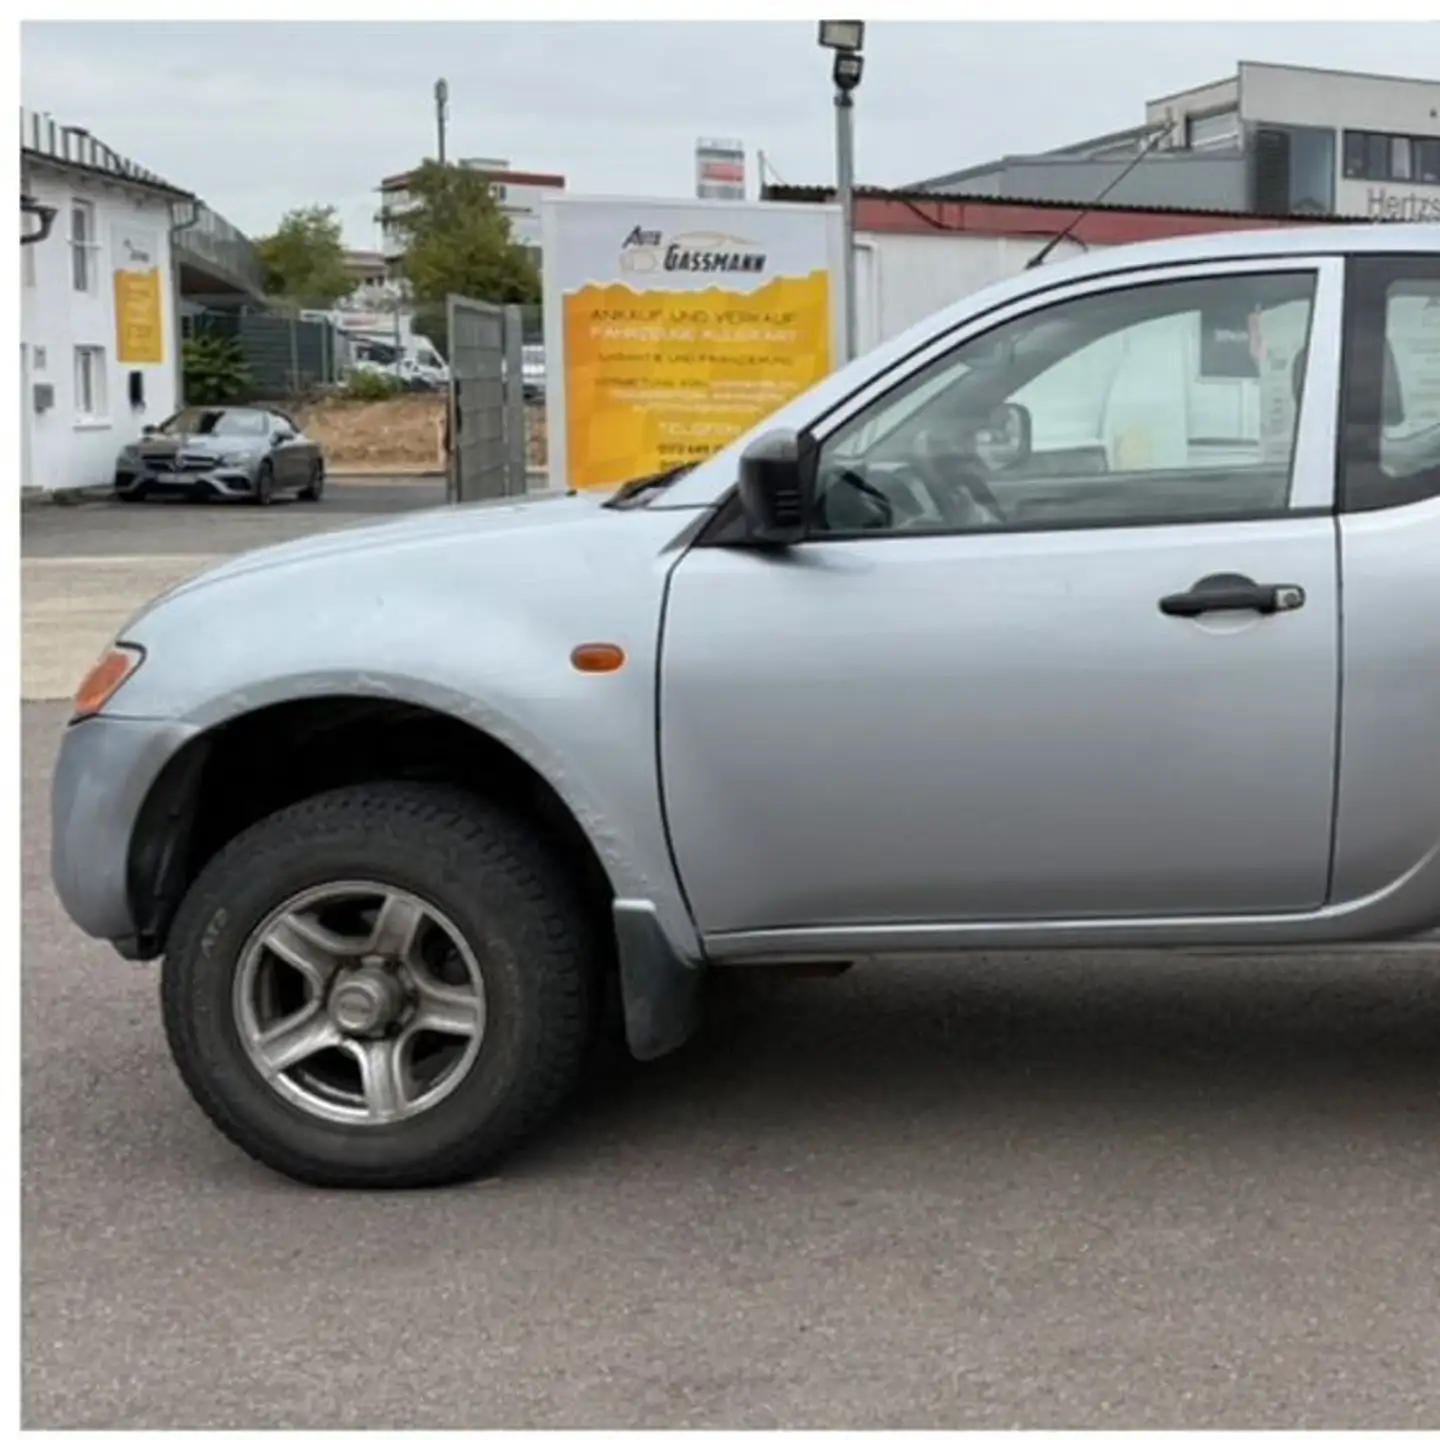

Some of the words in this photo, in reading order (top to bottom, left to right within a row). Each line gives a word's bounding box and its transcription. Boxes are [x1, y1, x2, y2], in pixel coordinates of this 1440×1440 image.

[663, 243, 767, 273] GASSMANN
[669, 309, 709, 325] UND
[716, 311, 798, 325] VERKAUF
